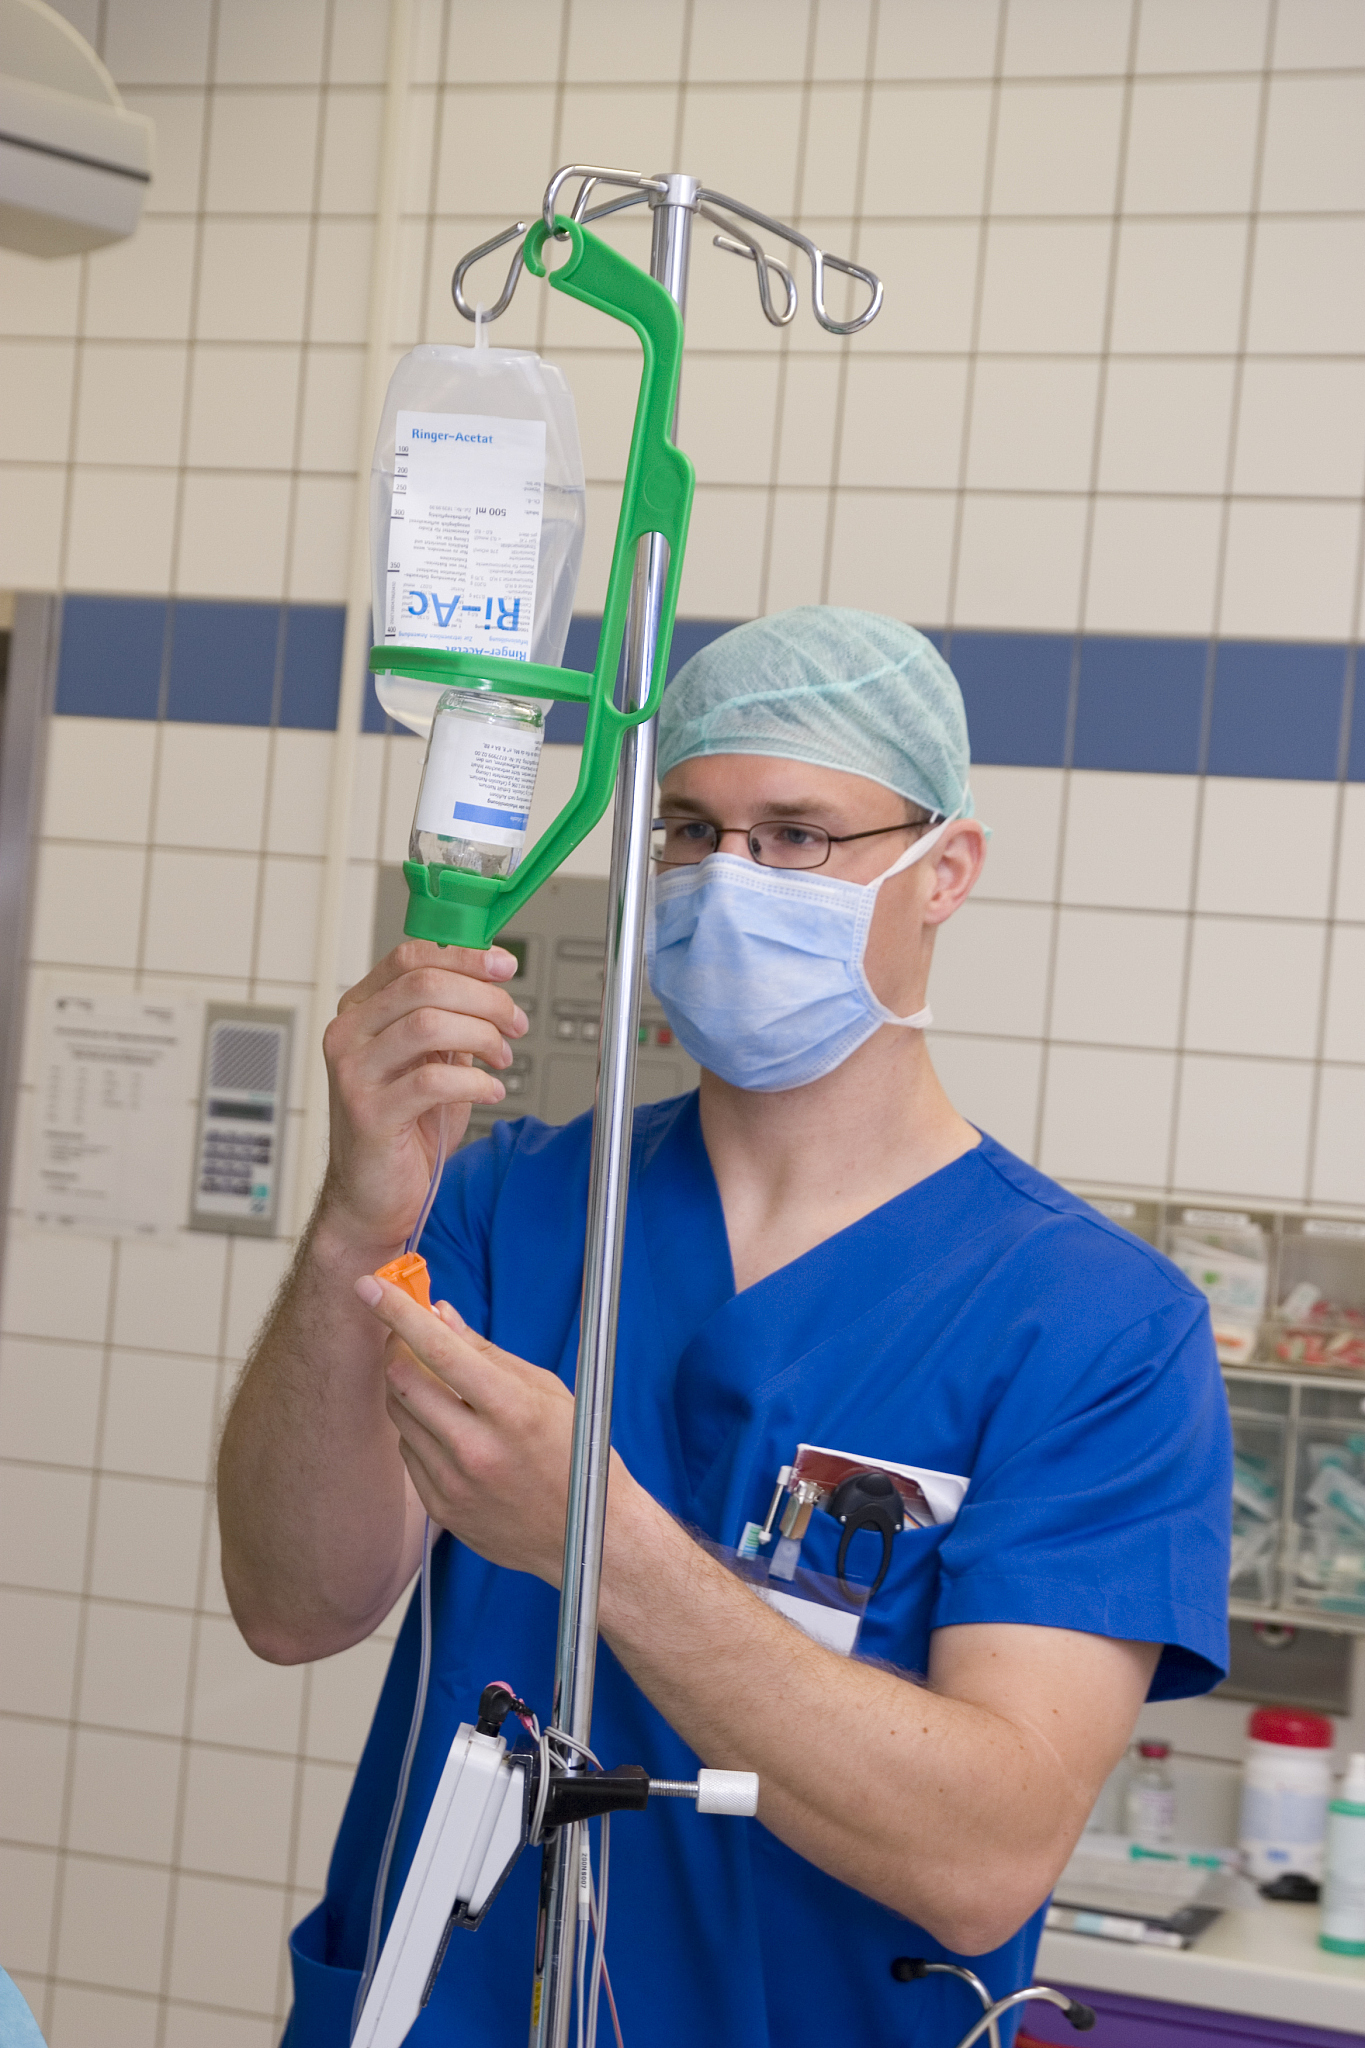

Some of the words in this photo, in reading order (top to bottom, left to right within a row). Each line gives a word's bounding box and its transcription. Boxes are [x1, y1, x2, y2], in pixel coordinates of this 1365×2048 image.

[412, 429, 493, 444] Ringer-Acetat
[476, 507, 486, 515] ml
[489, 508, 506, 516] 500
[408, 590, 520, 631] Ri-Ac
